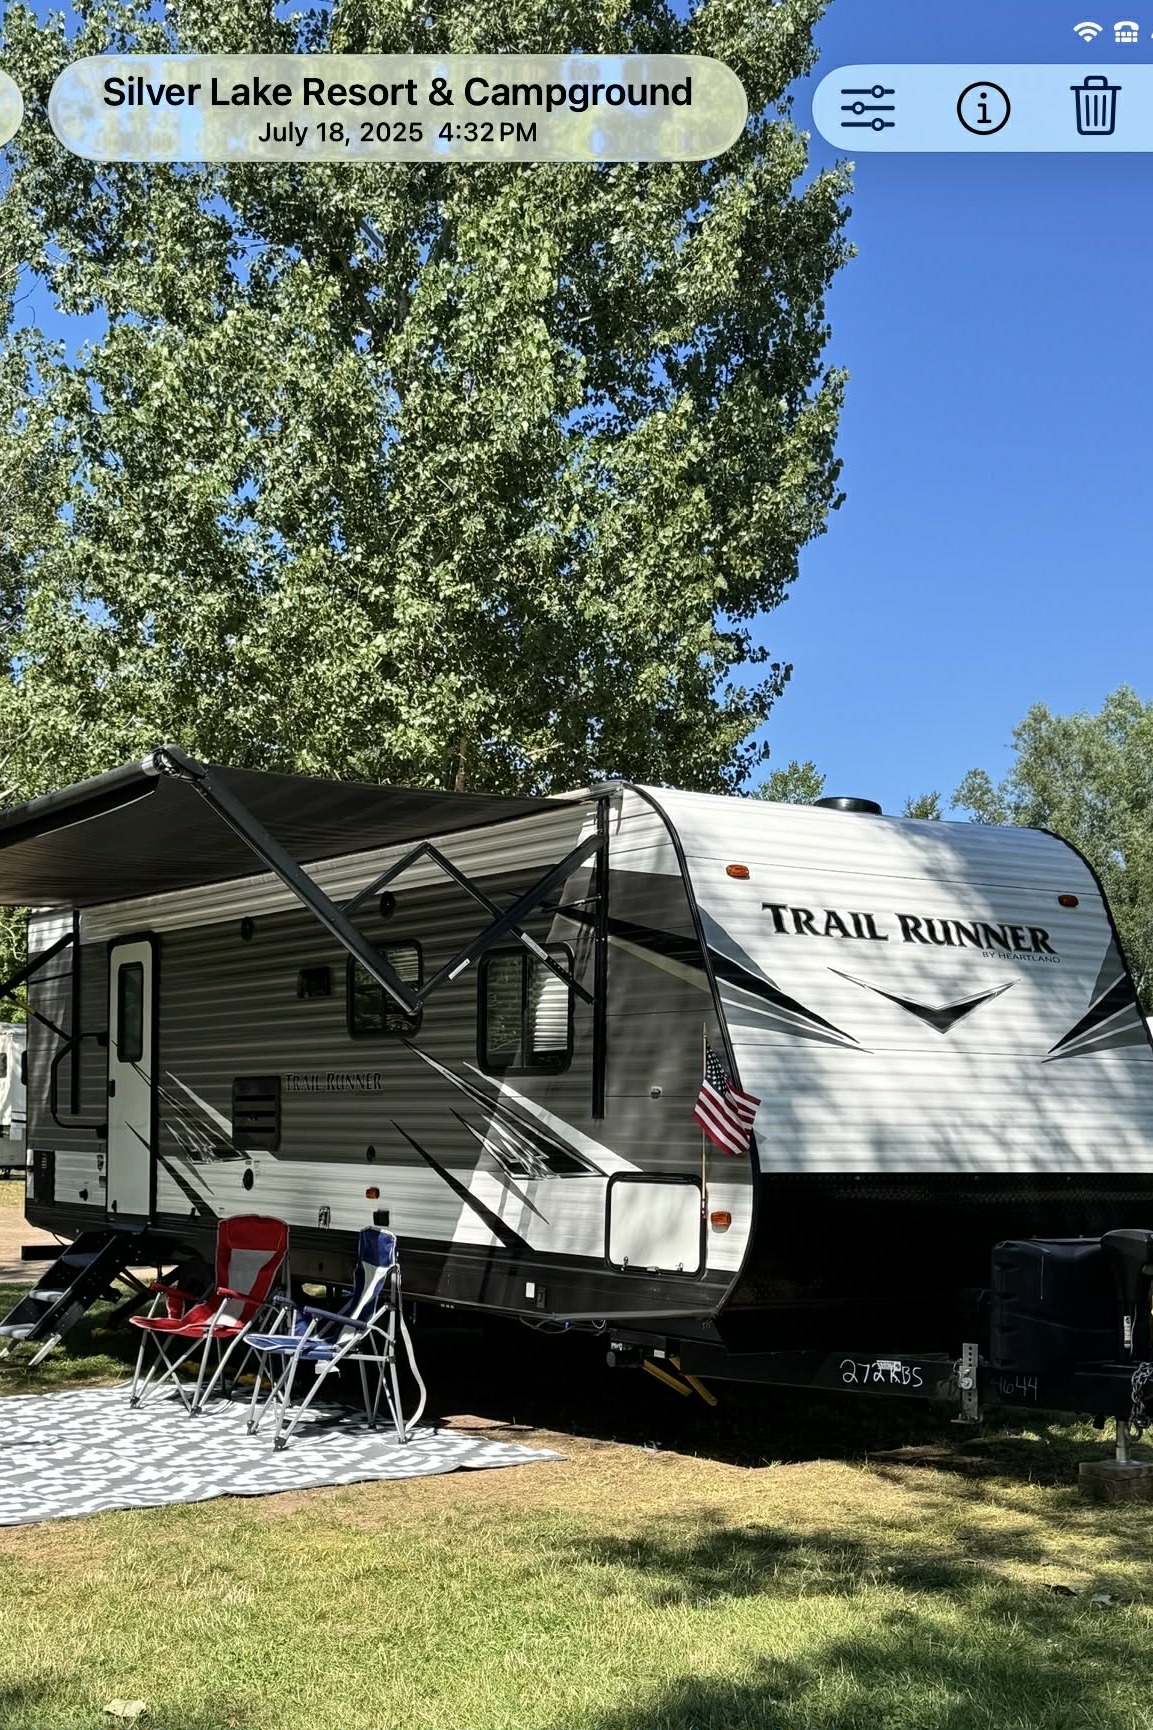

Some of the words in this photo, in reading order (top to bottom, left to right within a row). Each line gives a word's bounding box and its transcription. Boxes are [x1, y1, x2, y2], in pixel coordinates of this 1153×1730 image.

[762, 902, 889, 942] TRAIL
[894, 912, 1059, 955] RUNNER
[998, 952, 1061, 964] HEARTLAND
[285, 1074, 323, 1091] TRAIL
[326, 1073, 383, 1091] RUNNER
